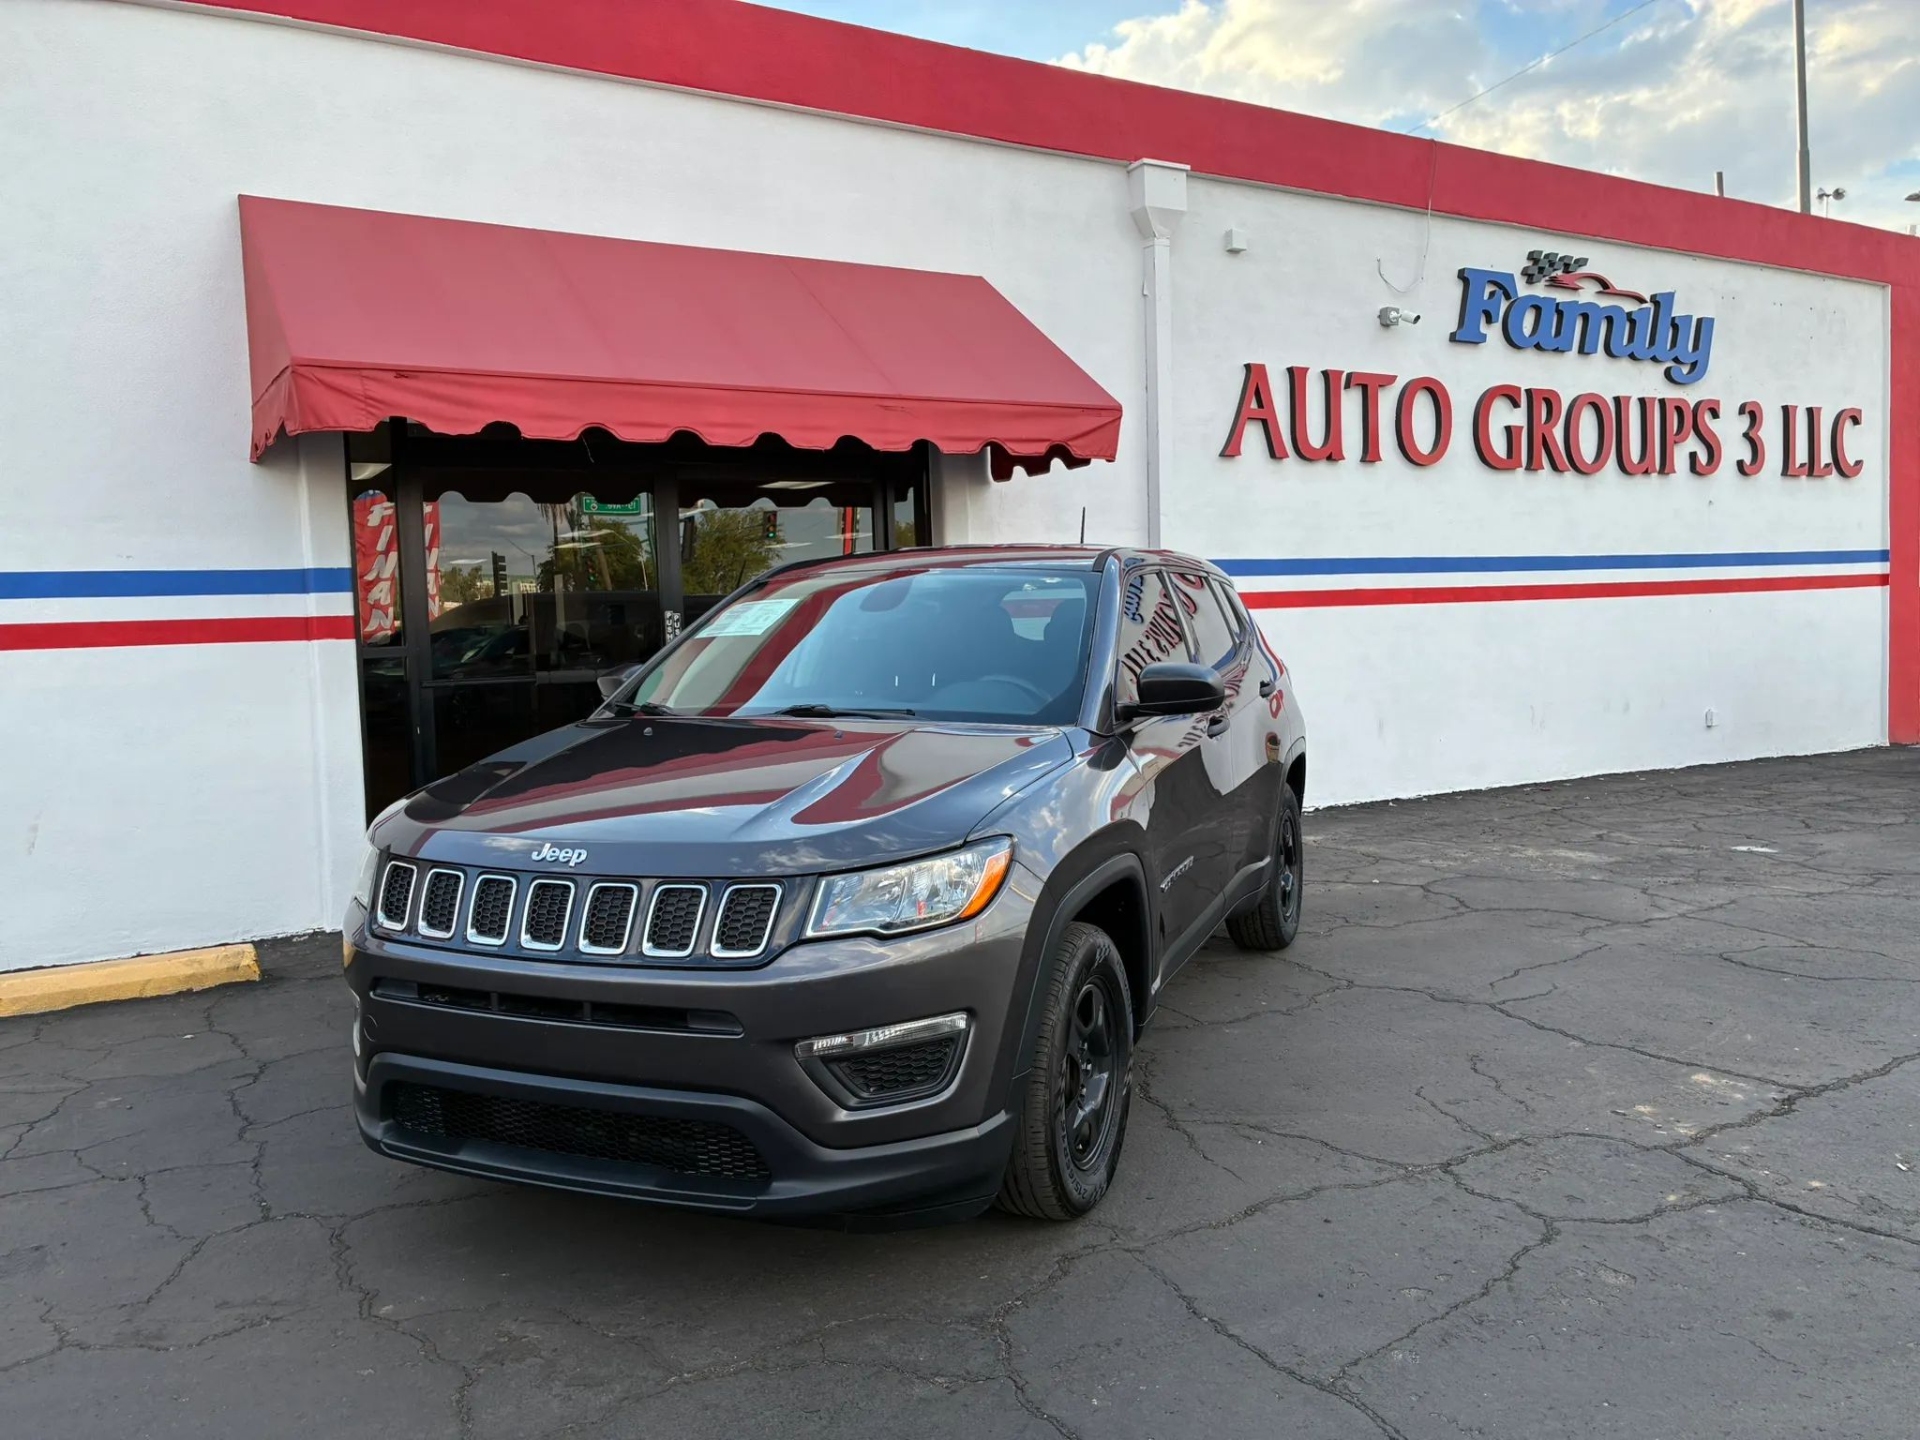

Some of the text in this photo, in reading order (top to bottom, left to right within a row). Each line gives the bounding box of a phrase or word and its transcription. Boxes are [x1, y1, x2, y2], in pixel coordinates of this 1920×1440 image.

[1449, 266, 1714, 385] Family
[1219, 363, 1864, 478] AUTO GROUPS 3 LLC
[673, 614, 681, 636] PUS
[531, 843, 588, 867] Jeep
